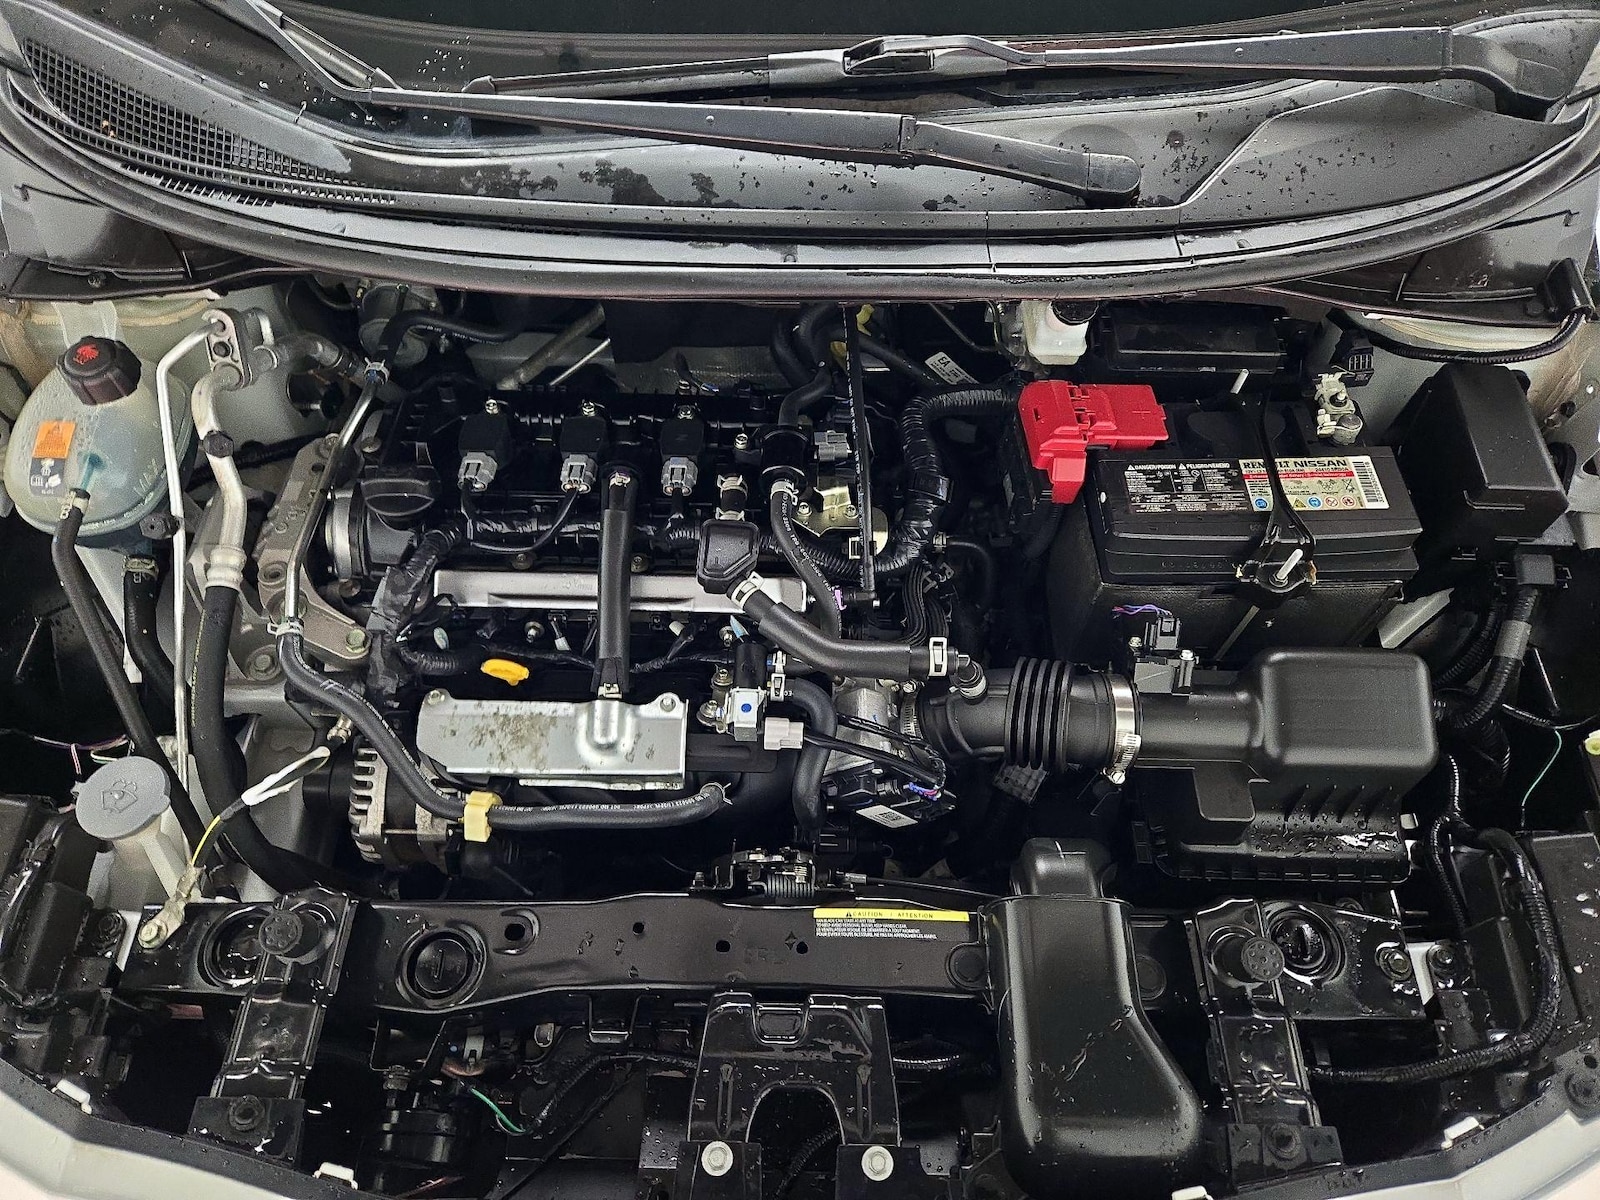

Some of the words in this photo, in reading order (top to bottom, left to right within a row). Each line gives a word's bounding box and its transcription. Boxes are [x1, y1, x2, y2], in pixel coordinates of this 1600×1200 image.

[938, 356, 951, 367] EA
[1243, 460, 1290, 469] RENLT
[1293, 459, 1347, 468] NISSAN
